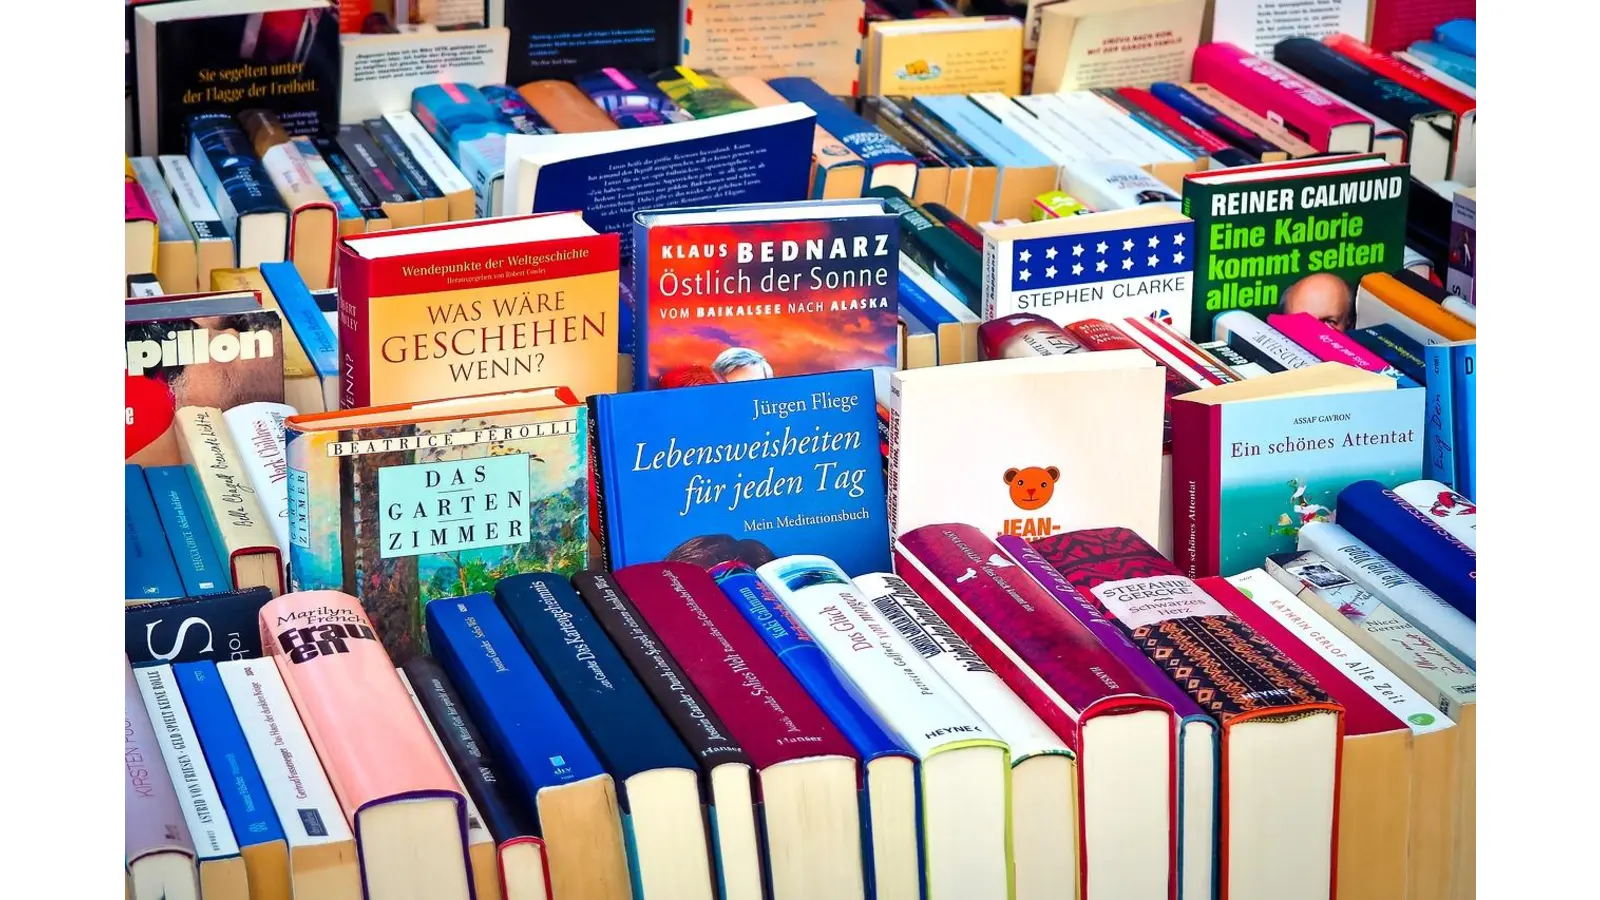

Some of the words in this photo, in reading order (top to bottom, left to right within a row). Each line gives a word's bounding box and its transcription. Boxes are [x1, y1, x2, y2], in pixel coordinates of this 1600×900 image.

[199, 68, 216, 81] Sie
[218, 64, 267, 81] segelten
[270, 61, 304, 76] unter
[183, 88, 204, 104] der
[206, 86, 245, 104] Flagge
[247, 84, 268, 98] der
[270, 80, 319, 95] Freiheit.
[1211, 188, 1294, 217] REINER
[1301, 176, 1402, 210] CALMUND
[1210, 220, 1265, 251] Eine
[1275, 212, 1363, 244] Kalorie
[402, 261, 482, 277] Wendepunkte
[485, 257, 504, 271] der
[508, 248, 589, 267] Weltgeschichte
[661, 243, 728, 260] KLAUS
[737, 234, 889, 264] BEDNARZ
[1208, 250, 1300, 281] kommt
[1308, 242, 1385, 272] selten
[659, 268, 751, 297] Östlich
[760, 267, 802, 293] der
[810, 265, 888, 290] Sonne
[1018, 286, 1103, 310] STEPHEN
[1113, 276, 1185, 300] CLARKE
[427, 300, 482, 326] WAS
[493, 290, 566, 318] WÄRE
[660, 307, 690, 320] VOM
[696, 303, 782, 318] BAIKALSEE
[788, 301, 824, 314] NACH
[830, 297, 888, 311] ALASKA
[1206, 281, 1278, 311] allein
[381, 311, 606, 364] GESCHEHEN
[449, 353, 545, 383] WENN?
[753, 398, 807, 420] Jürgen
[812, 392, 859, 415] Fliege
[1293, 416, 1318, 427] ASSAF
[1318, 412, 1351, 424] GAVRON
[1431, 393, 1445, 432] Dein
[334, 435, 453, 456] BEATRICE
[474, 421, 572, 443] FEROLLI
[632, 426, 861, 472] Lebensweisheiten
[1230, 442, 1261, 459] Ein
[1268, 435, 1335, 455] schönes
[1342, 429, 1415, 447] Attentat
[425, 465, 486, 488] DAS
[680, 474, 727, 515] für
[729, 468, 803, 511] jeden
[814, 462, 866, 498] Tag
[289, 472, 297, 541] GARTEN
[299, 474, 307, 544] ZIMMER
[388, 490, 523, 520] GARTEN
[744, 519, 773, 532] Mein
[776, 508, 870, 529] Meditationsbuch
[389, 520, 523, 550] ZIMMER
[1103, 578, 1192, 599] STEFANIE
[1118, 586, 1193, 603] GERCKE
[277, 605, 354, 627] Marilyn
[307, 614, 367, 625] French
[532, 580, 584, 649] Kartengeheimnis
[740, 587, 776, 625] Gallmann
[819, 605, 855, 633] Glück
[838, 591, 876, 622] morgen
[1129, 598, 1206, 614] Schwarzes
[1158, 607, 1193, 617] Herz
[767, 619, 787, 639] Kuki
[1366, 618, 1399, 628] Nicci
[1367, 622, 1412, 633] Gerrard
[146, 616, 214, 661] S
[278, 623, 378, 654] Frau
[290, 639, 350, 664] en
[576, 644, 595, 661] Das
[850, 629, 873, 652] Das
[1269, 599, 1312, 630] KATHRIN
[1310, 631, 1347, 659] GERLOF
[1345, 662, 1375, 681] Alle
[1374, 683, 1405, 705] Zeit
[722, 651, 745, 673] Welt
[147, 671, 165, 690] ROLLE
[154, 691, 172, 710] KEINE
[161, 711, 180, 732] SPIELT
[170, 733, 186, 750] GELD
[700, 746, 742, 757] Hanser
[777, 735, 823, 746] Hanser
[125, 752, 154, 799] KIRSTEN
